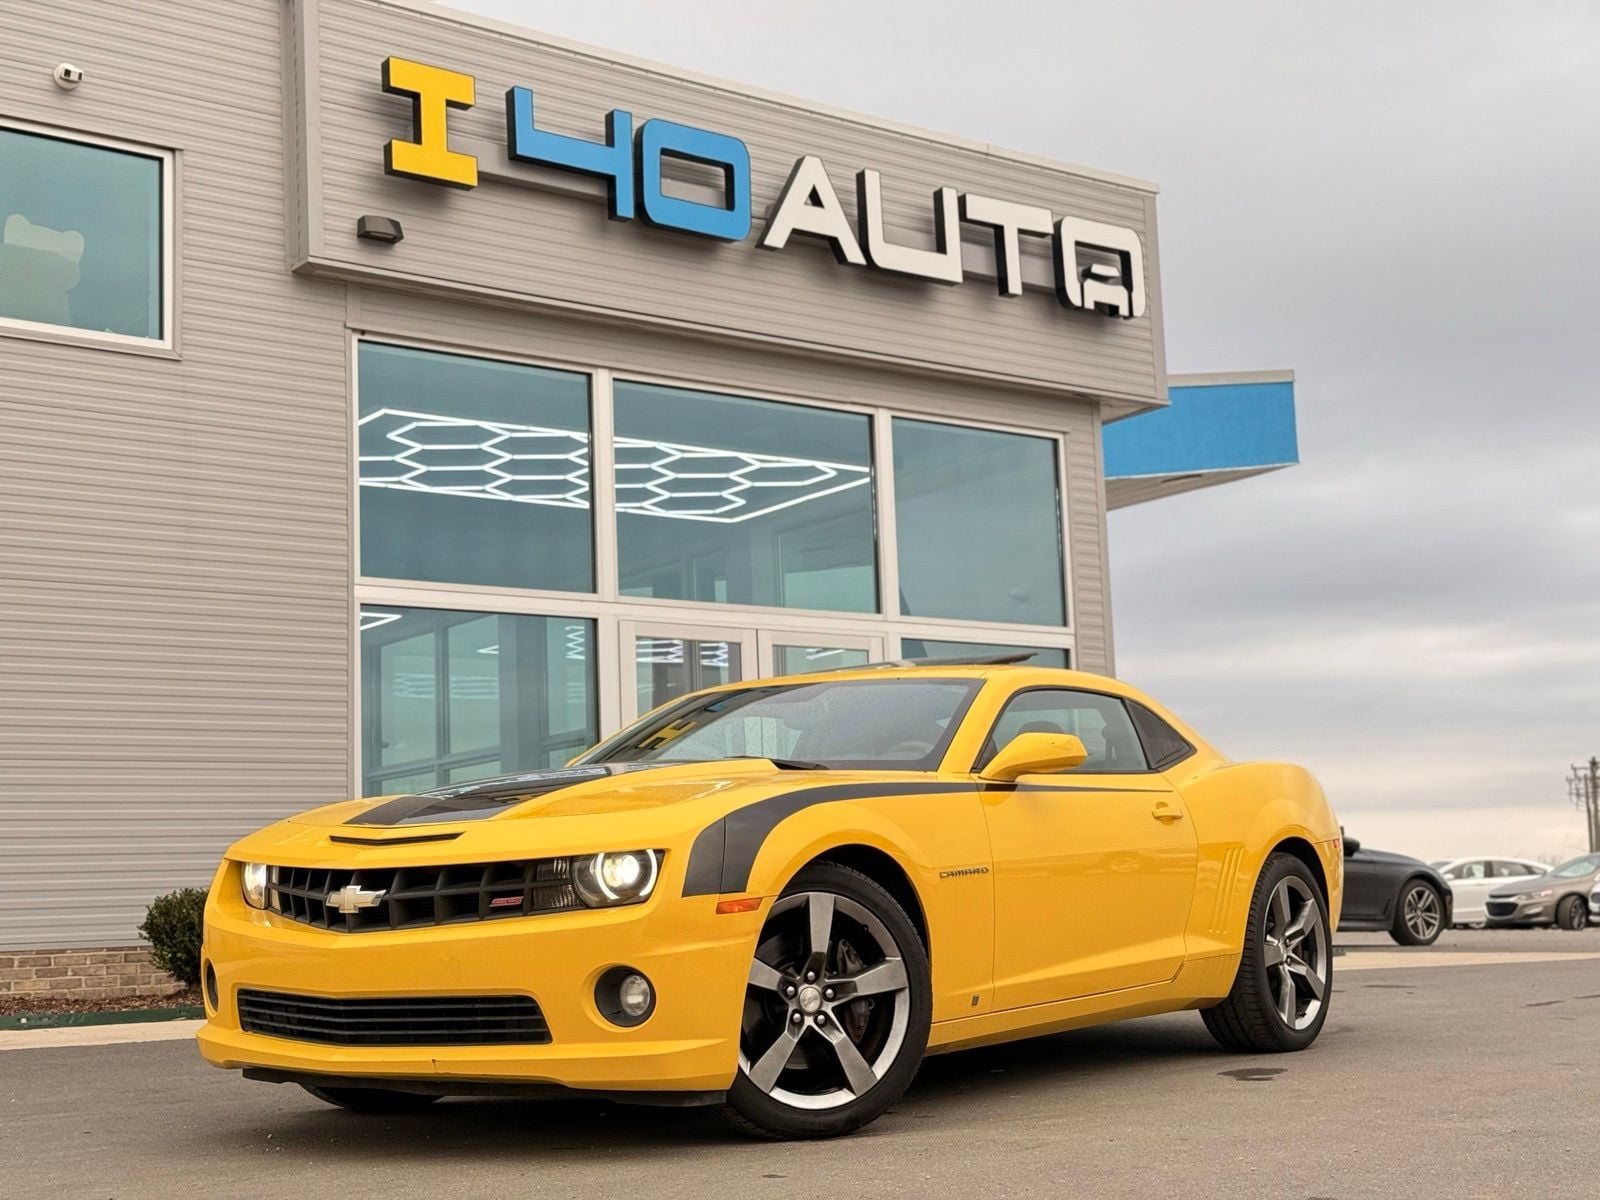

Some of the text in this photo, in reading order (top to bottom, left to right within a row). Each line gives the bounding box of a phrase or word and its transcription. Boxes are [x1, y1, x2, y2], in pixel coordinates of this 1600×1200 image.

[382, 56, 1146, 319] I 40 AUTO
